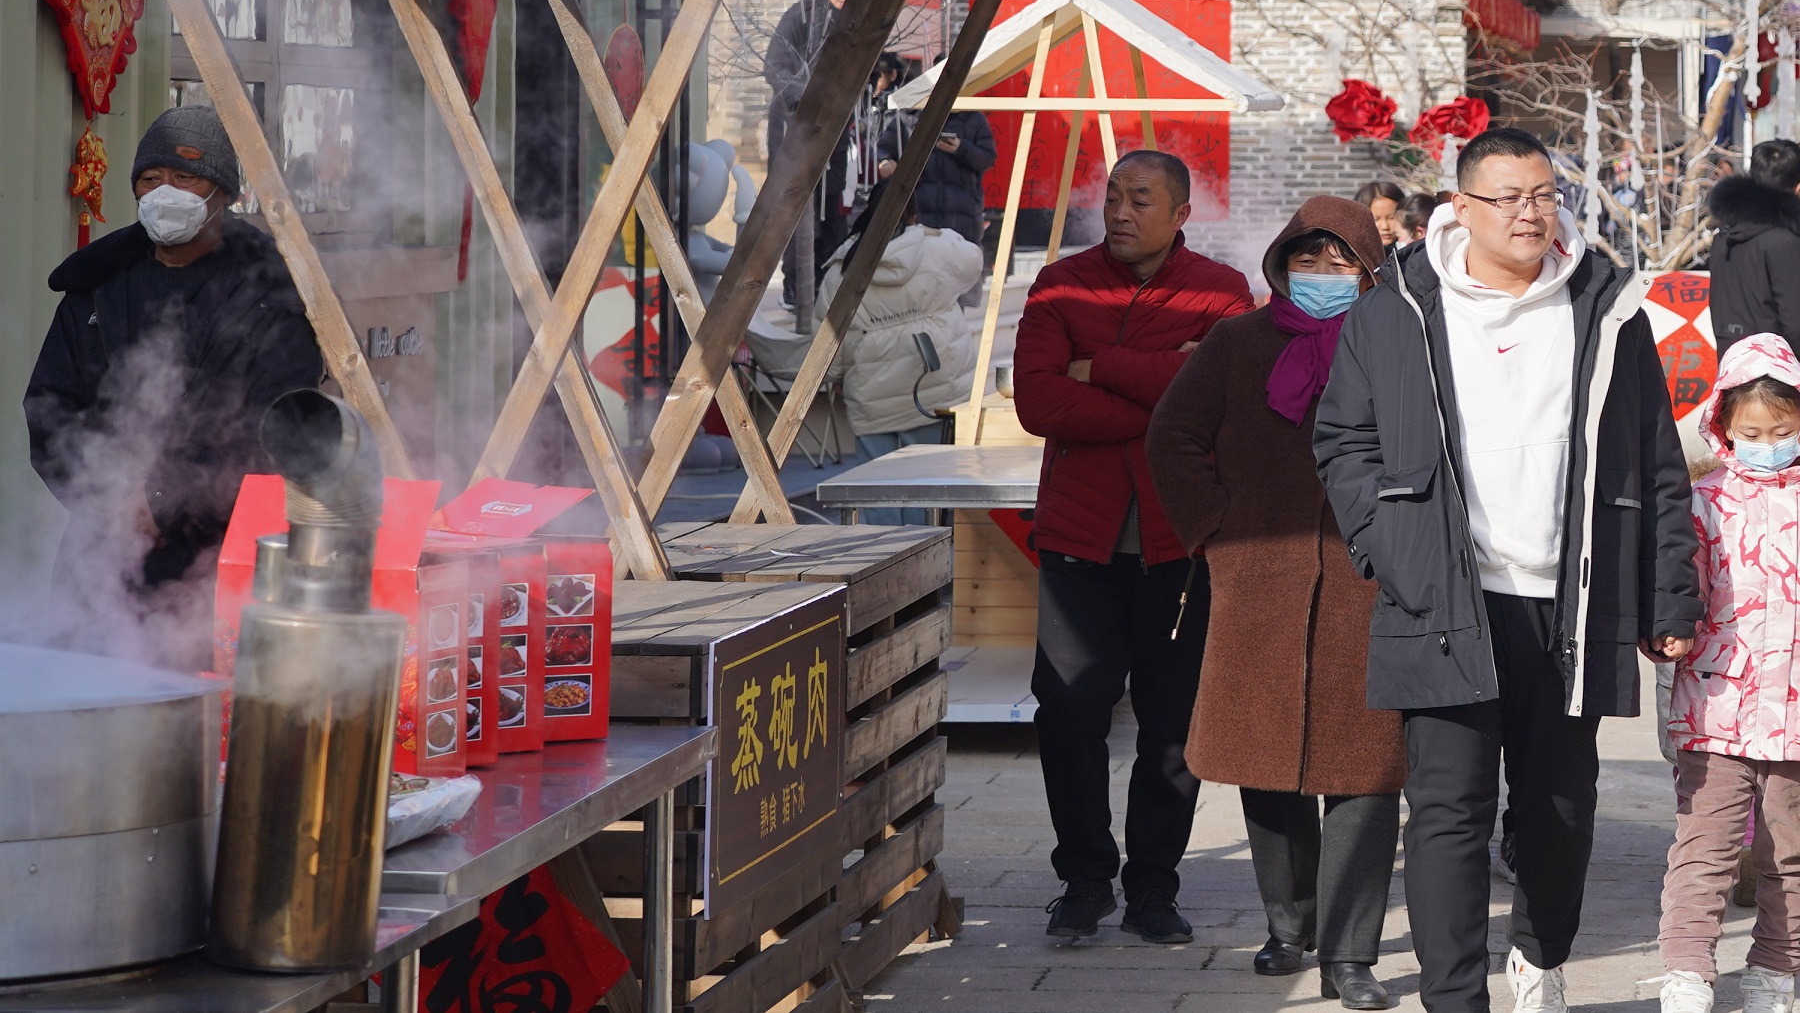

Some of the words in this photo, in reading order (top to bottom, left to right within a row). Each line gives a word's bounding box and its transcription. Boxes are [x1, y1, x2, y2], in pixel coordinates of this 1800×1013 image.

[1656, 276, 1710, 304] 福
[731, 646, 829, 795] 蒸碗肉
[760, 792, 778, 839] 熟食
[781, 775, 806, 825] 猪下水
